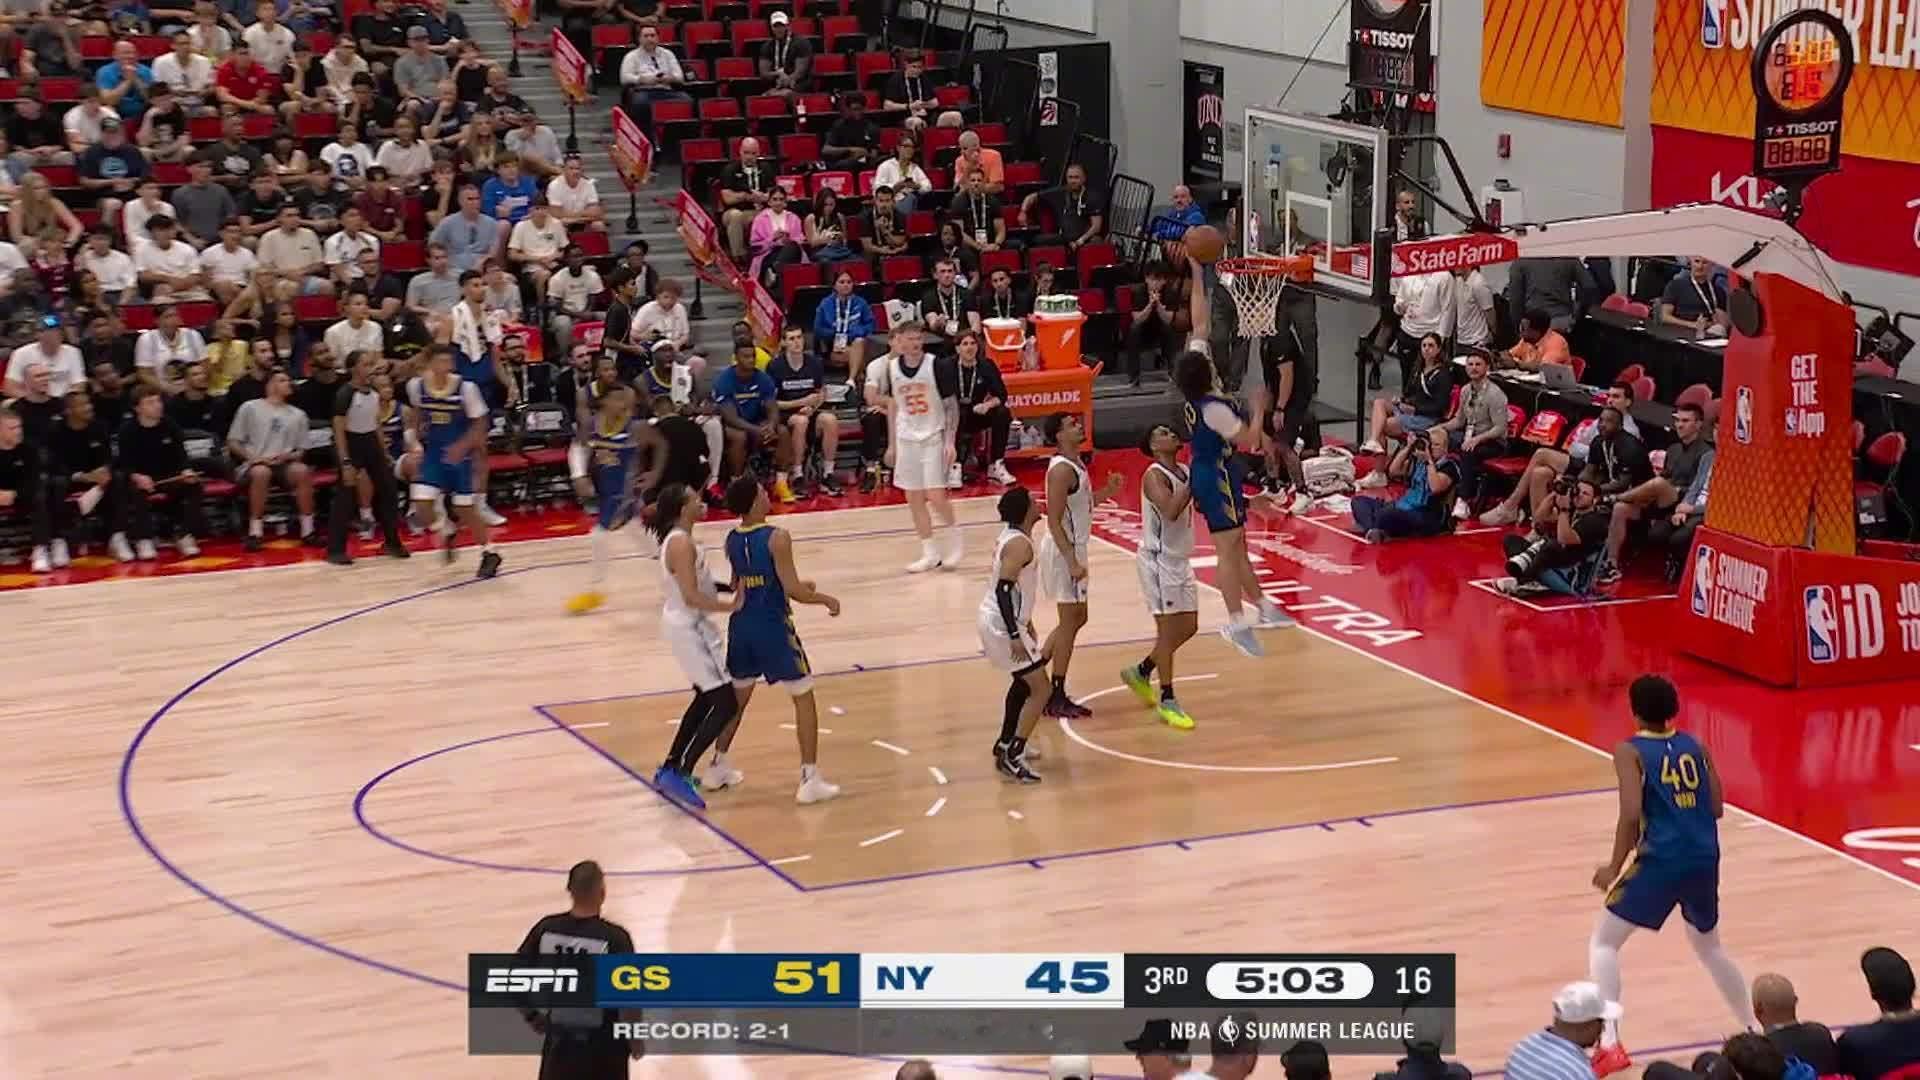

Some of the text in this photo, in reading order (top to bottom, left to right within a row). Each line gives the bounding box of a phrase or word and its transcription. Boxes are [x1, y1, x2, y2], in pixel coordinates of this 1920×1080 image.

[1370, 29, 1414, 48] TISSOT
[1787, 120, 1838, 136] TISSOT
[1408, 241, 1503, 273] State Farm
[1791, 354, 1818, 380] GET
[1005, 389, 1081, 408] GATORADE
[1792, 380, 1819, 406] THE
[1798, 407, 1825, 438] App
[1717, 552, 1769, 602] SUMMER
[1713, 585, 1756, 634] LEAGUE
[1897, 582, 1920, 616] JO
[1841, 583, 1885, 659] iD
[1661, 753, 1700, 790] 40
